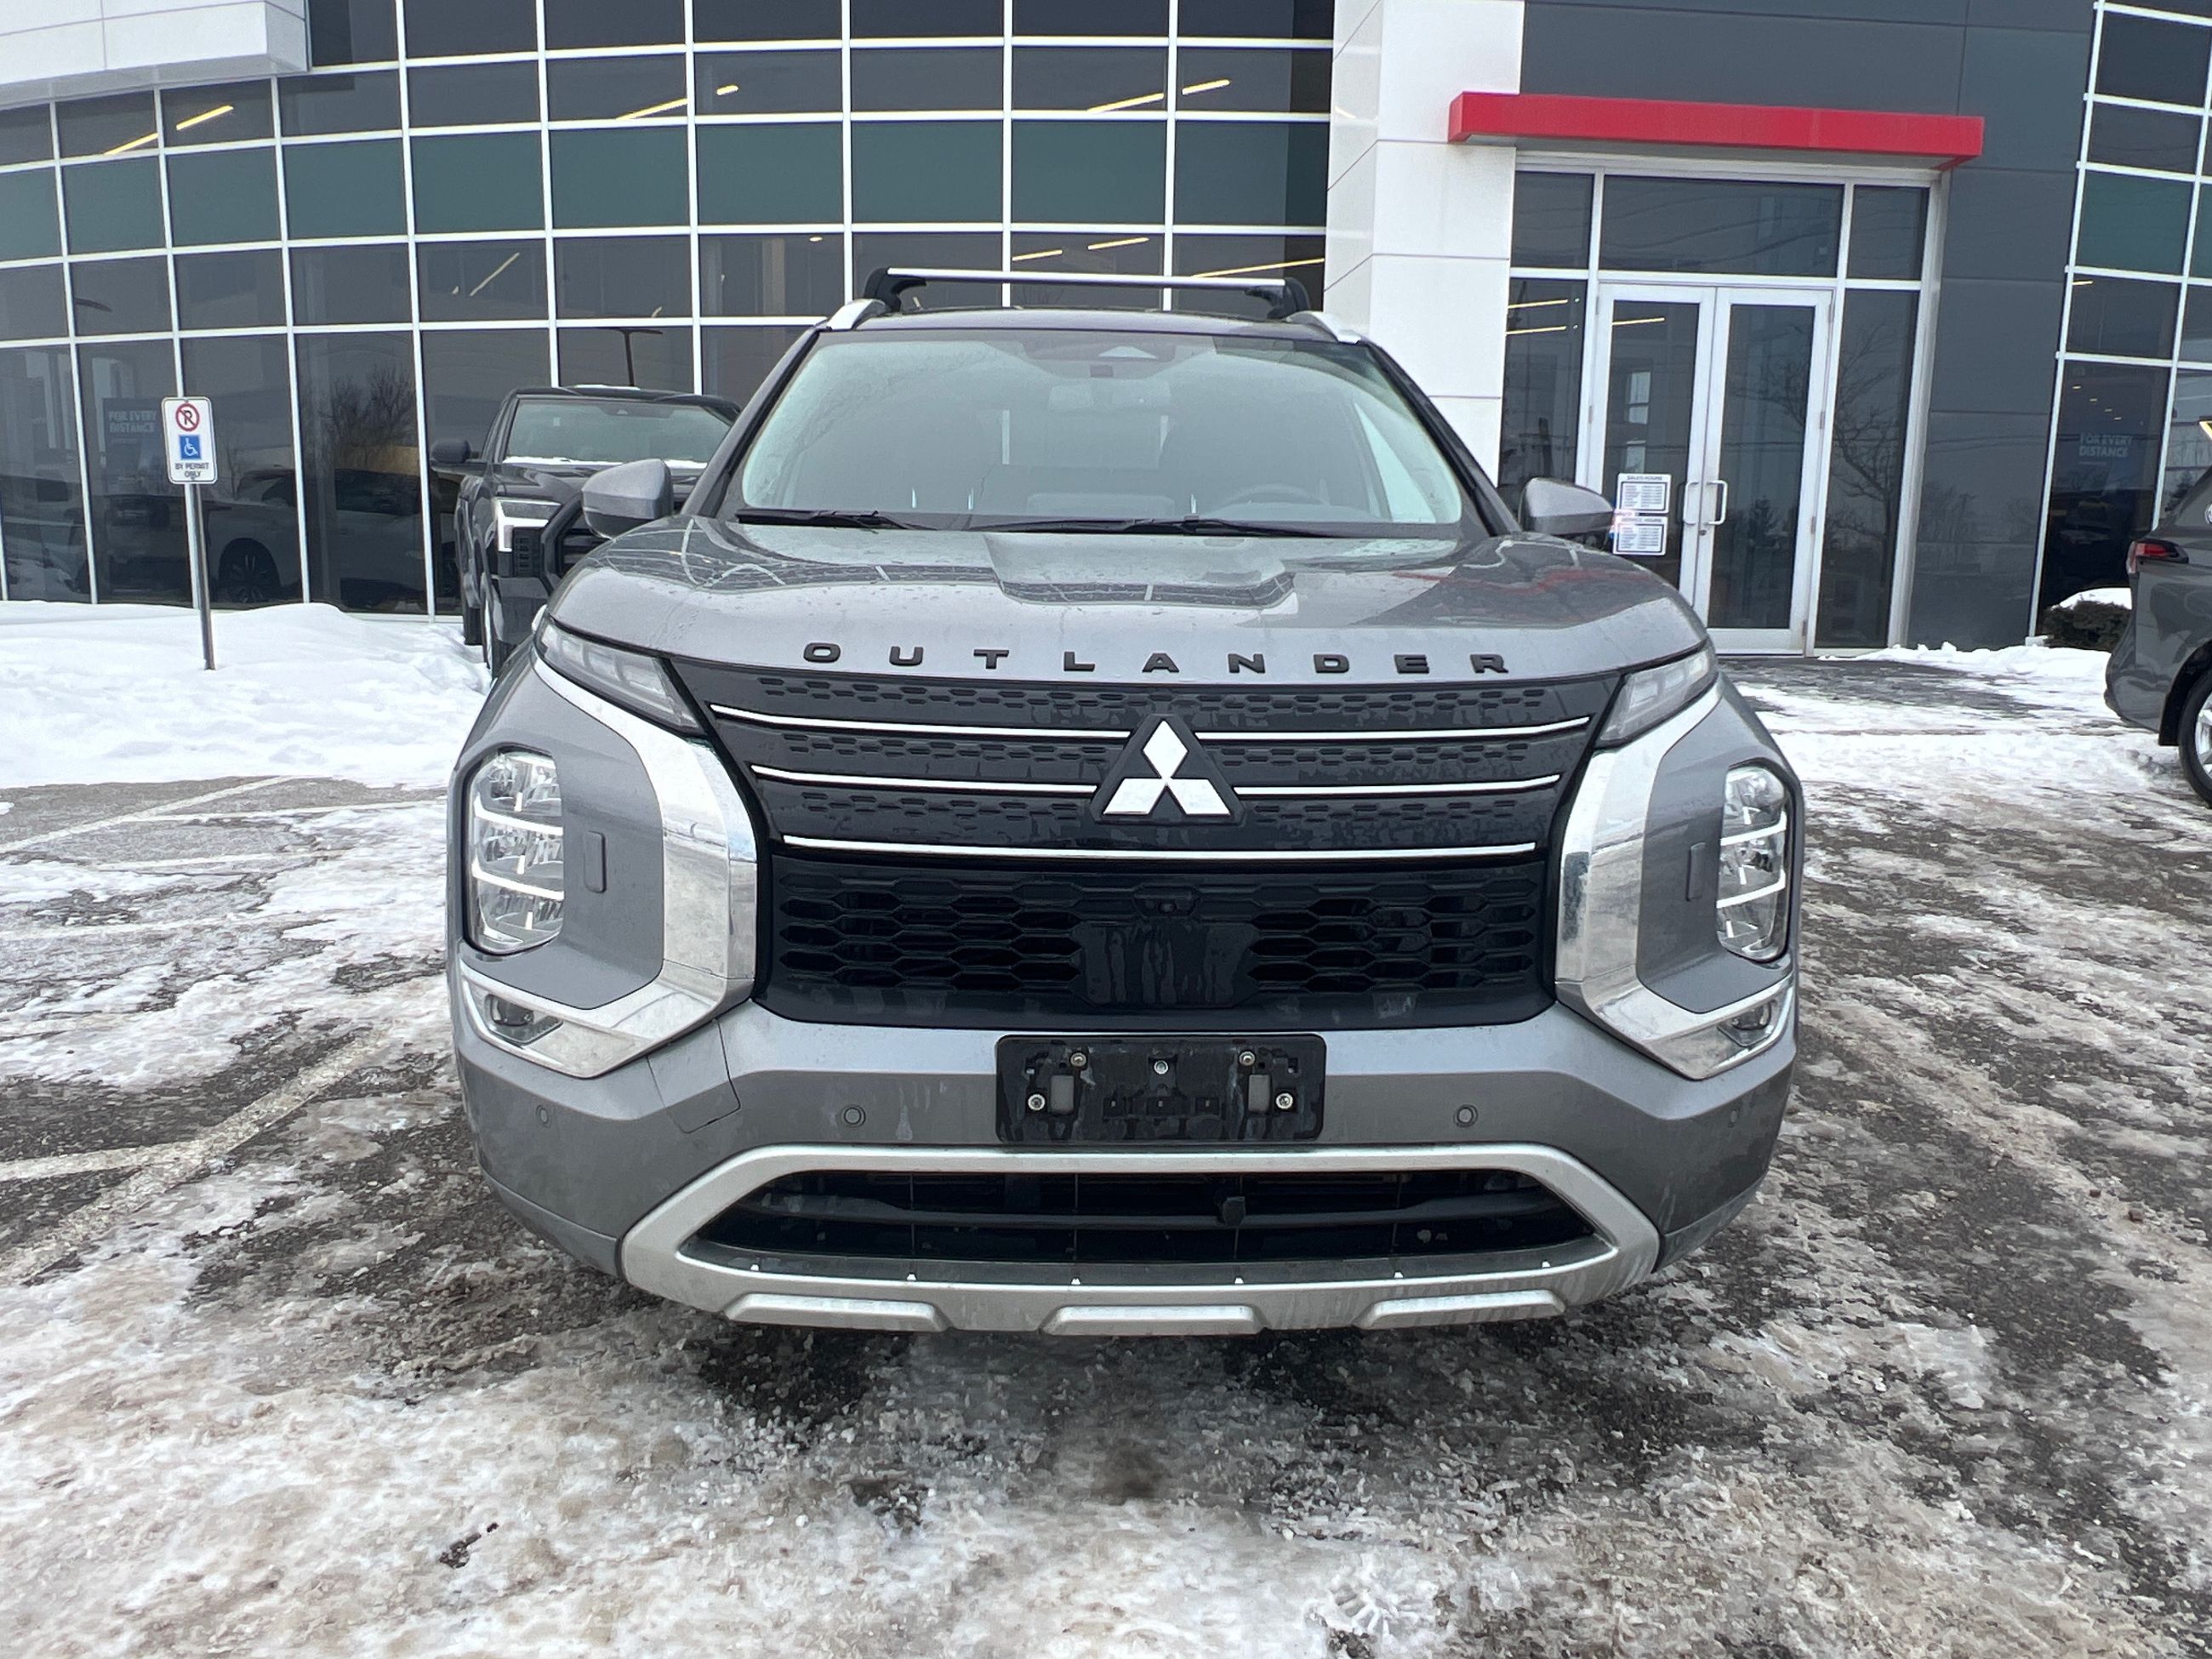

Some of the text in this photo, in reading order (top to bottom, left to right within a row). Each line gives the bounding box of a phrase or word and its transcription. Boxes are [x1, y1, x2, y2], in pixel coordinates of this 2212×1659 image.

[2078, 446, 2129, 458] DISTANCE
[185, 462, 209, 470] PERMIT
[803, 642, 1509, 674] OUTLANDER
